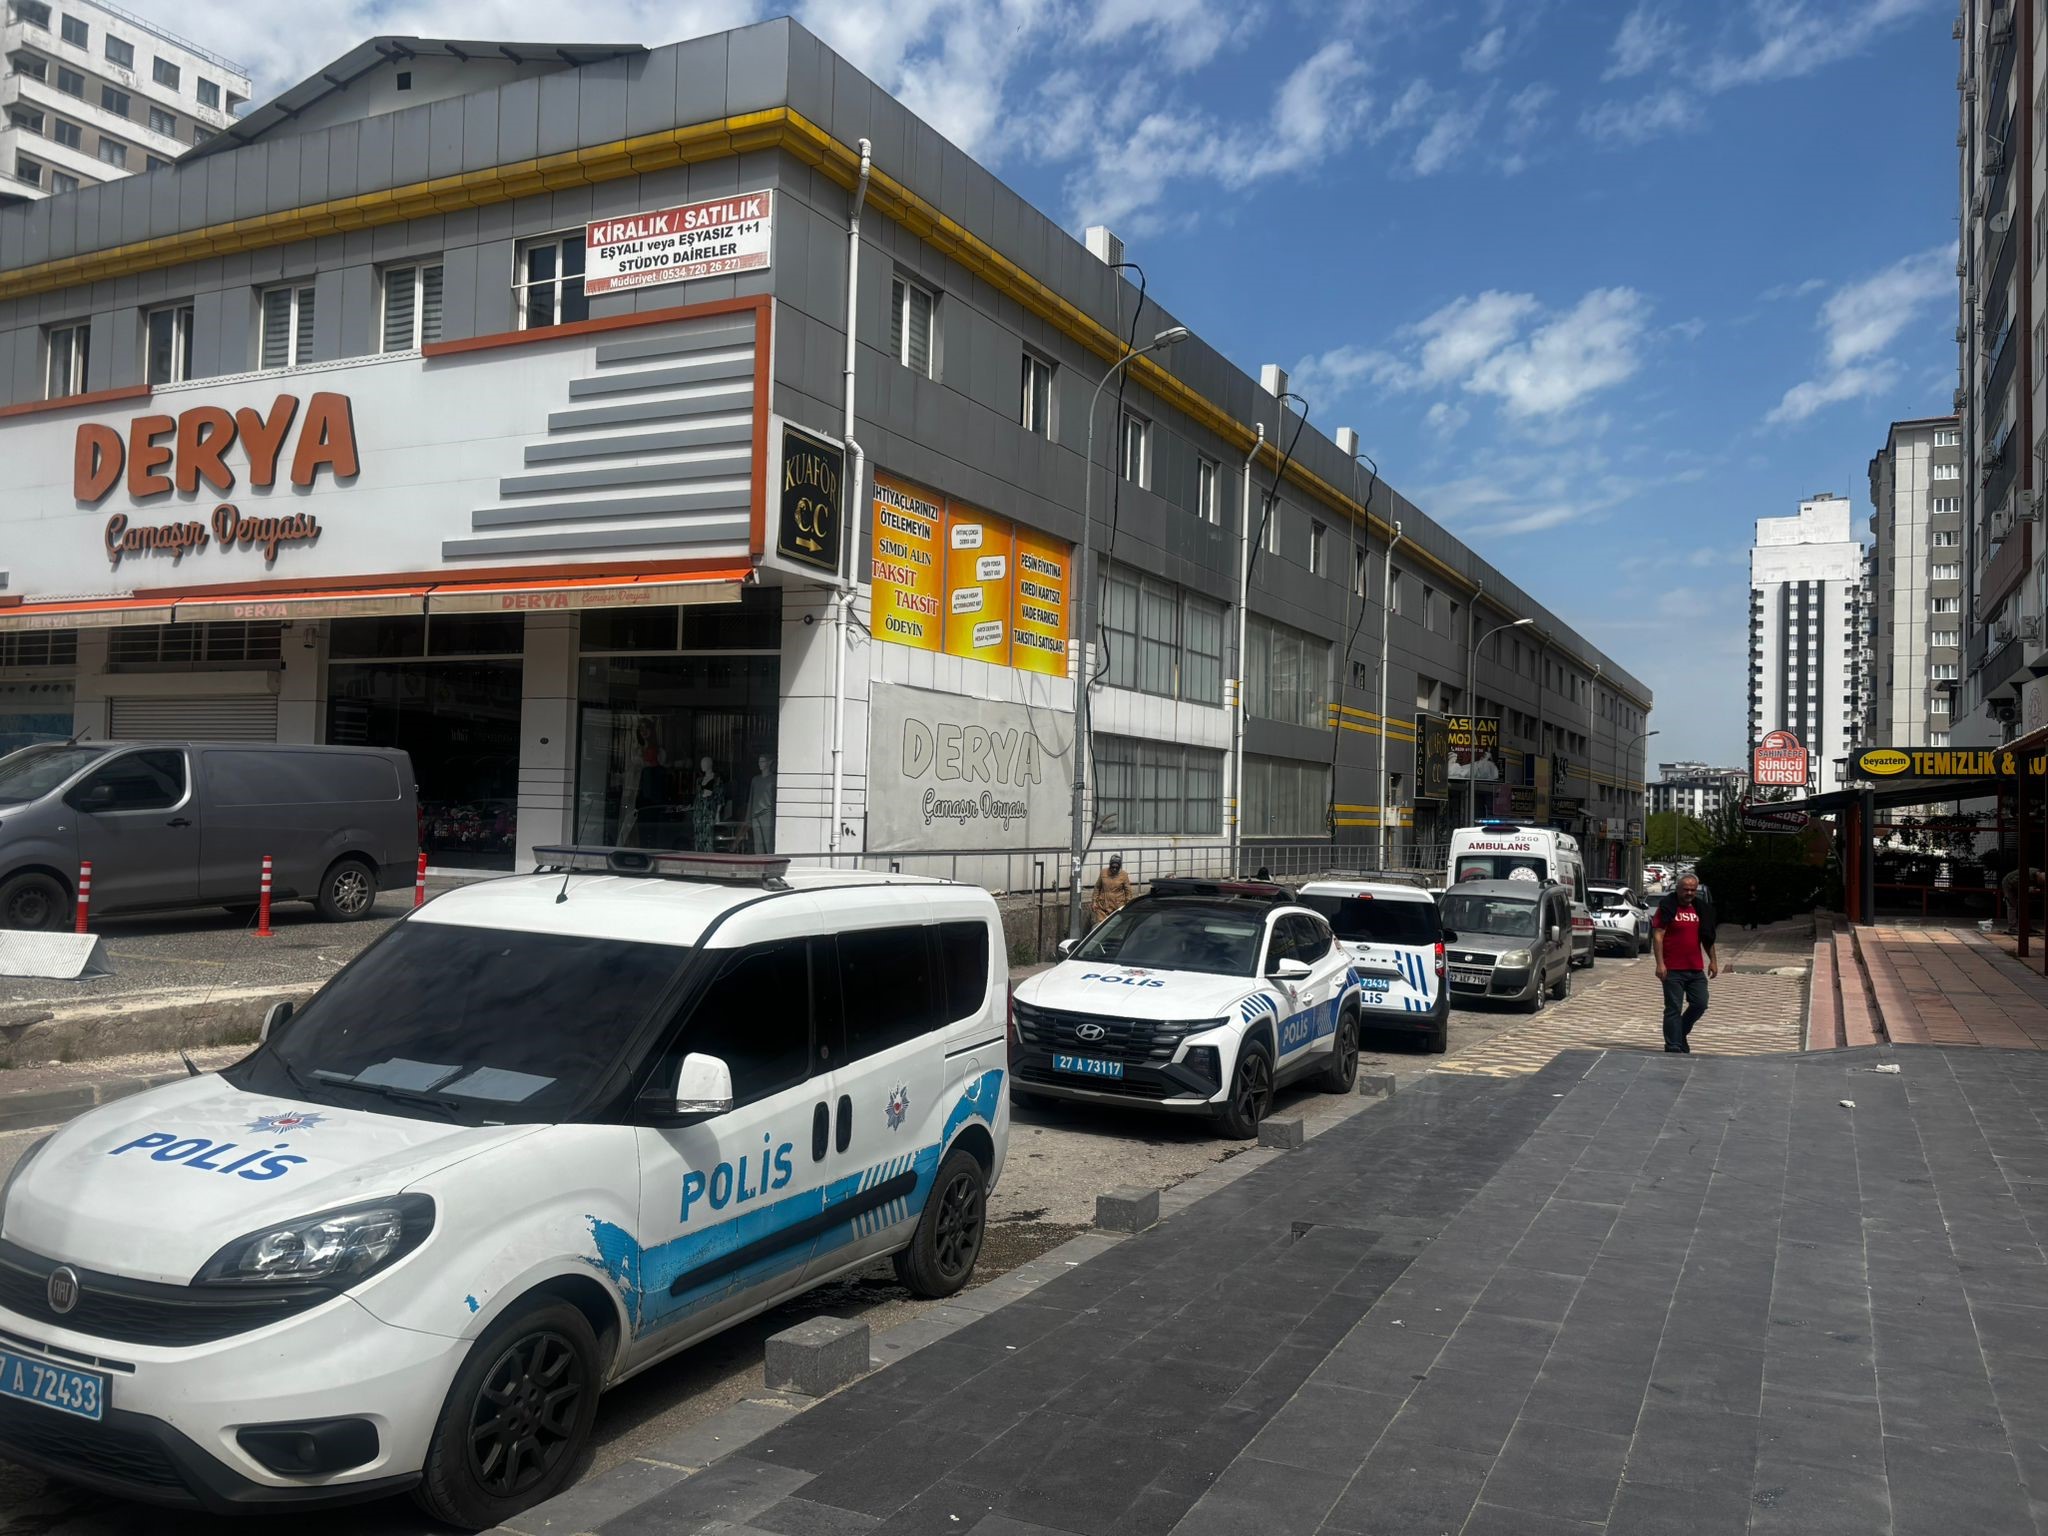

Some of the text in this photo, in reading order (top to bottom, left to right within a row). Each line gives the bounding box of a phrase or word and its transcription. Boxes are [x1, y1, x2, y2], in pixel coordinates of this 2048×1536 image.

[592, 198, 762, 245] KİRALIK / SATILIK
[600, 221, 760, 260] EŞYALI veya EŞYASIZ 1+1
[618, 242, 737, 273] STÜDYO DAİRELER
[610, 258, 740, 288] Müdüriyet (0534 720 26 27)
[74, 391, 360, 502] DERYA
[784, 453, 837, 512] KUAFÖR
[873, 481, 938, 521] İHTİYAÇLARINIZI
[104, 503, 322, 563] Çamaşır Deryası
[880, 508, 931, 540] ÖTELEMEYİN
[910, 548, 931, 566] ALIN
[1020, 554, 1061, 578] PEŞİN FİYATINA
[872, 559, 917, 587] TAKSİT
[502, 592, 568, 608] DERYA
[895, 589, 938, 616] TAKSİT
[1020, 580, 1060, 604] KREDİ KARTSIZ
[234, 604, 288, 618] DERYA
[1022, 605, 1059, 626] VADE FARKSIZ
[885, 614, 923, 637] ÖDEYİN
[1014, 629, 1037, 648] TAKSİTLİ
[1038, 633, 1065, 653] SATIŞLAR!
[1449, 718, 1497, 732] ASLAN
[1448, 732, 1497, 746] MODA EVİ
[902, 718, 1041, 787] DERYA
[1758, 758, 1802, 770] SÜRÜCÜ
[1863, 757, 1906, 770] beyaztem
[1912, 752, 1997, 775] TEMİZLİK
[2002, 752, 2016, 775] &
[1758, 770, 1802, 783] KURSU
[922, 788, 1027, 831] Çamaşır Deryası
[1469, 842, 1530, 851] AMBULANS
[1080, 972, 1165, 988] POLİS
[1362, 978, 1388, 988] 73434
[1362, 992, 1383, 1004] LİS
[1282, 1016, 1309, 1047] POLİS
[1059, 1055, 1121, 1075] 27 A 73117
[107, 1132, 308, 1181] POLİS
[680, 1132, 794, 1224] POLİS
[53, 1280, 70, 1302] FIAT
[13, 1361, 24, 1392] A
[32, 1366, 96, 1412] 72433
